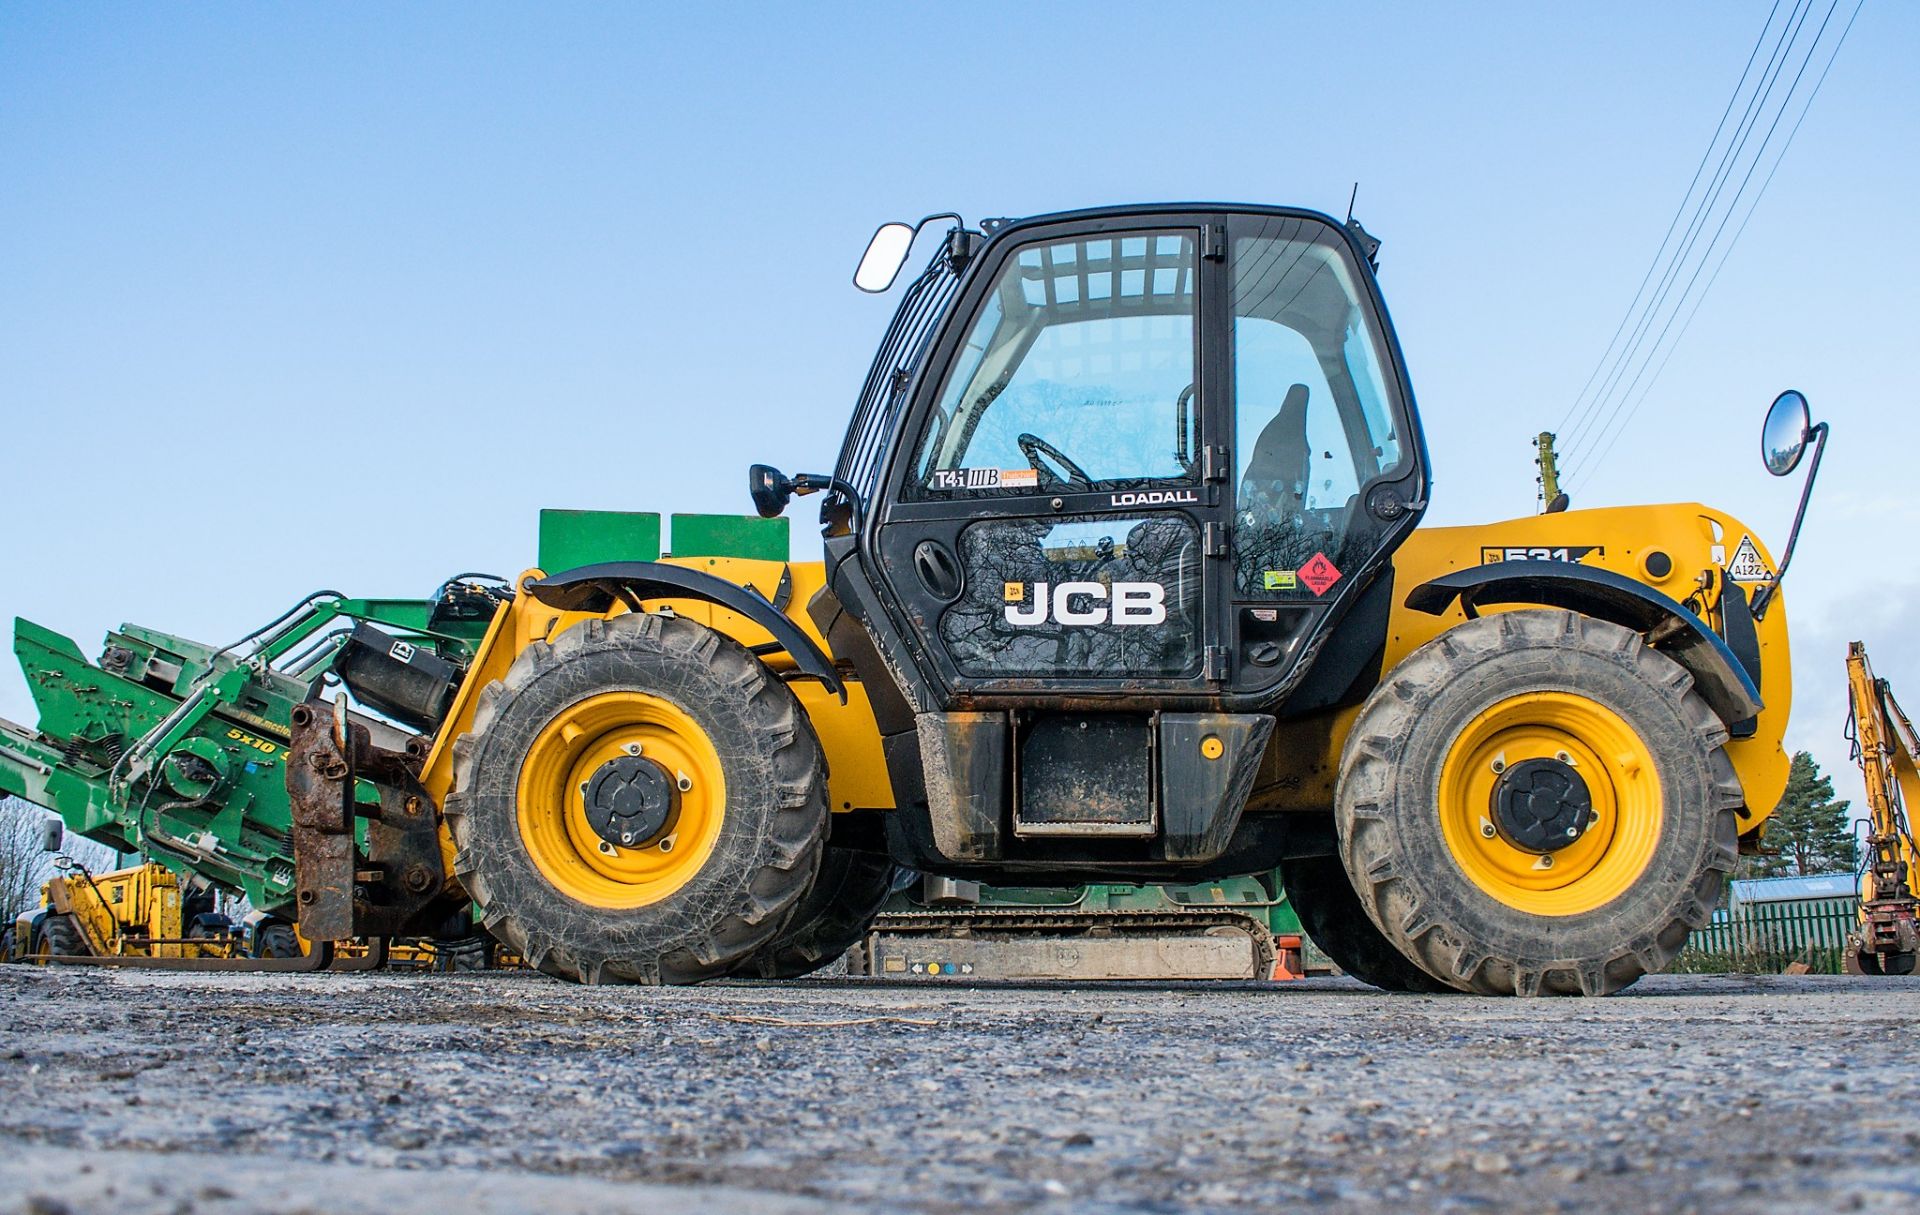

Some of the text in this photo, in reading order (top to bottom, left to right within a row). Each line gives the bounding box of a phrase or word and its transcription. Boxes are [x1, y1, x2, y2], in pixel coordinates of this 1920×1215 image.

[935, 470, 965, 488] T4i
[1111, 491, 1198, 506] LOADALL
[1740, 553, 1755, 563] 78
[1004, 581, 1166, 625] JCB
[227, 728, 276, 753] 5x10
